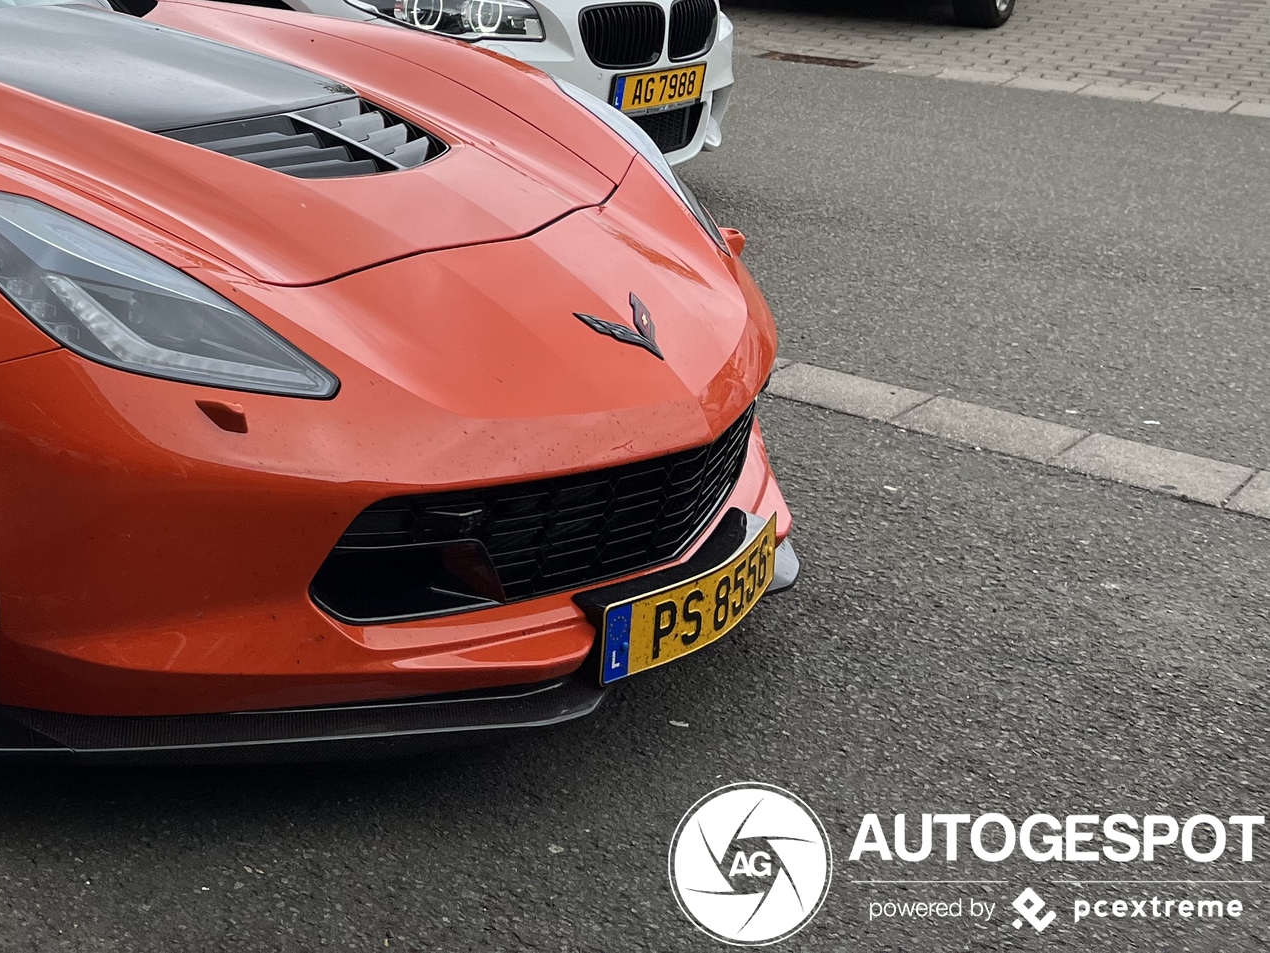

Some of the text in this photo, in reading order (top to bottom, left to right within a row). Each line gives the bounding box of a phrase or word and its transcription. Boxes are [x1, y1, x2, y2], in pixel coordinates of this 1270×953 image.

[632, 77, 655, 105] AG
[659, 70, 696, 101] 7988
[611, 535, 768, 669] L PS 8556
